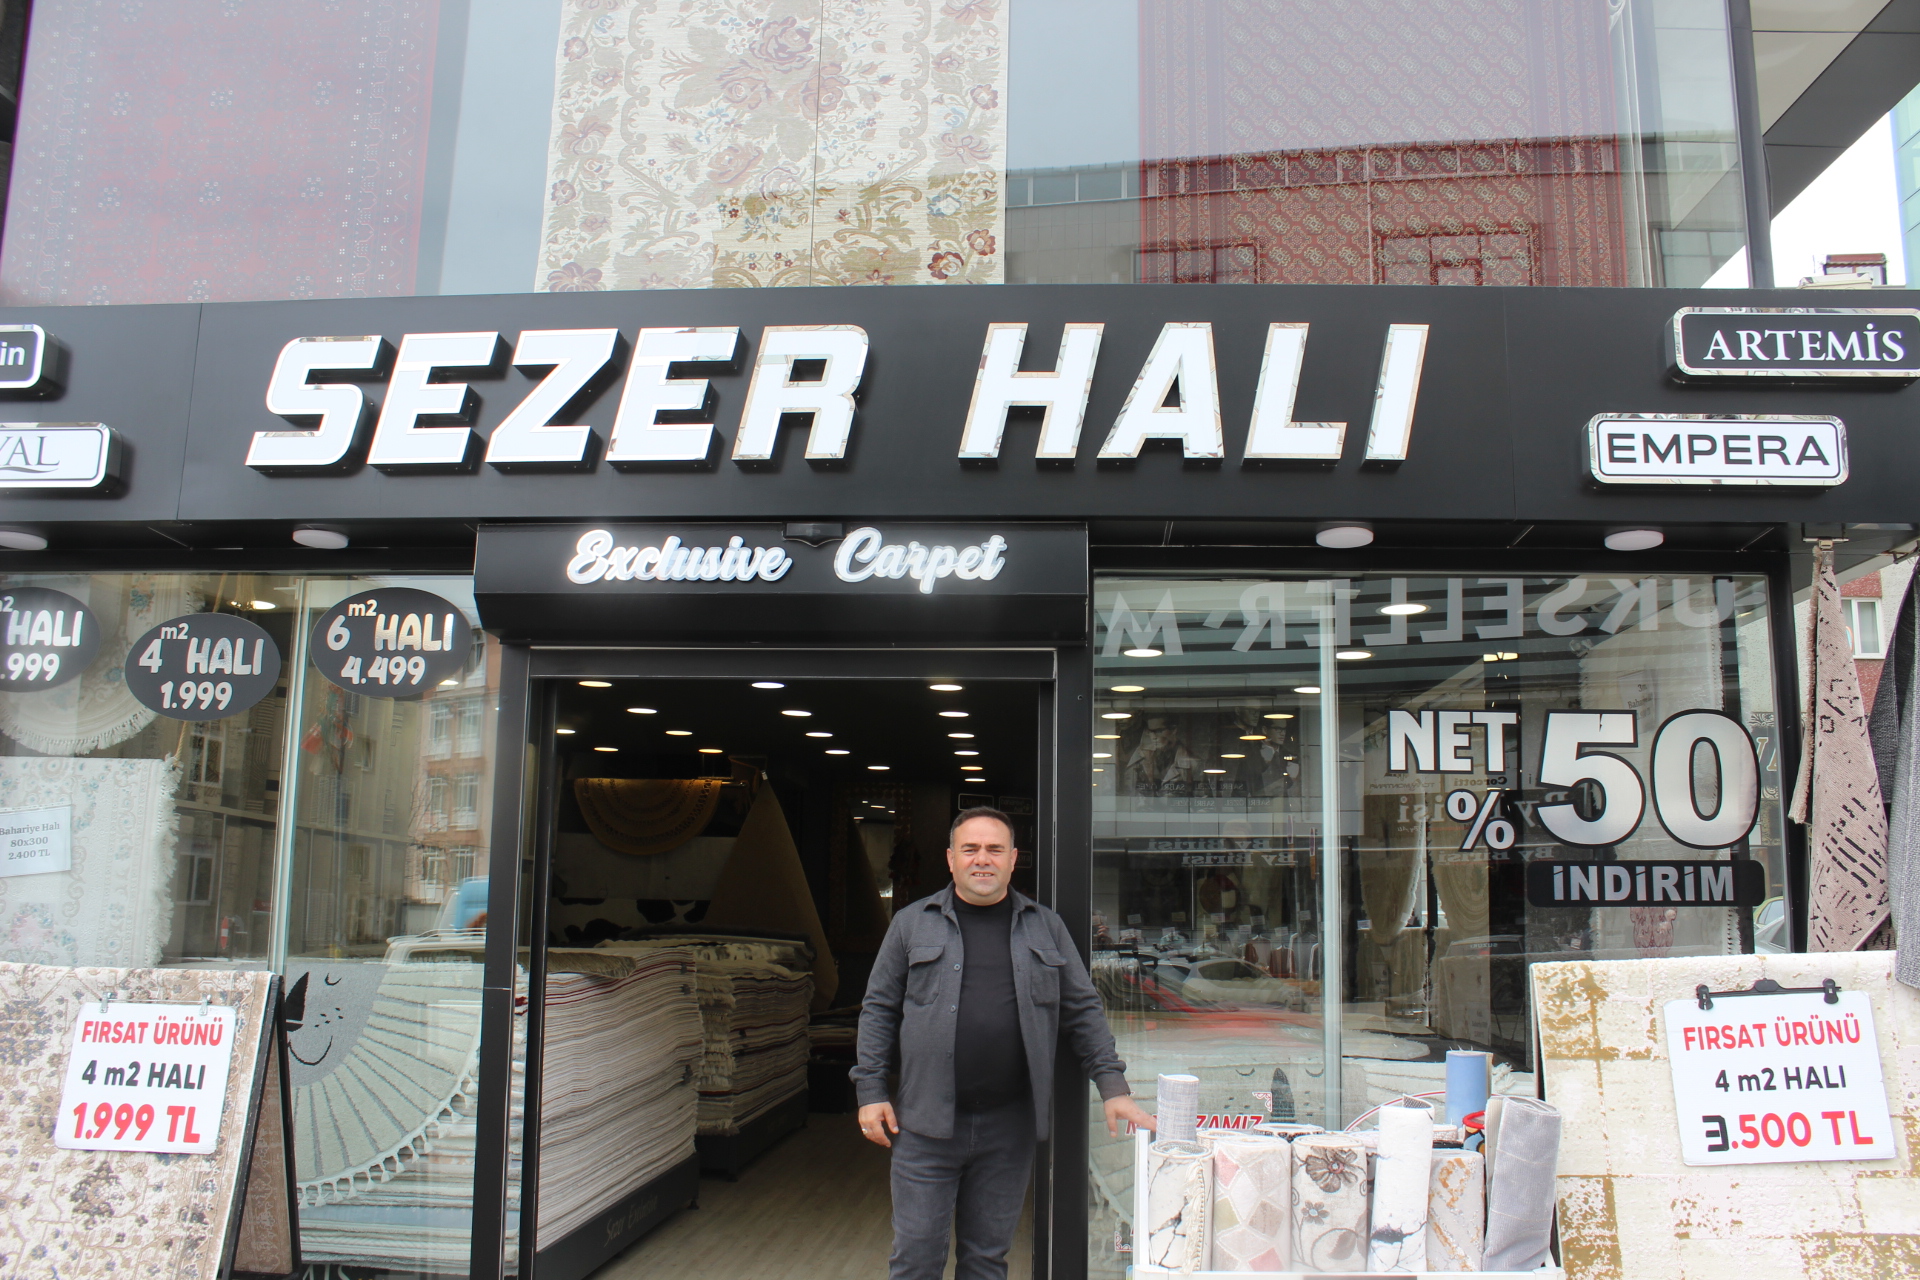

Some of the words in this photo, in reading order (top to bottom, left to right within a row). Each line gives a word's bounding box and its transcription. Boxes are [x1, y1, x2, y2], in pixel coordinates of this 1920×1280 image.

[245, 325, 870, 468] SEZER
[958, 321, 1431, 461] HALI
[1607, 433, 1830, 466] EMPERA
[564, 527, 793, 586] Exclusive
[833, 525, 1009, 595] Carpet
[6, 609, 84, 647] HALI
[326, 614, 351, 652] 6
[374, 613, 456, 652] HALI
[138, 638, 163, 674] 4
[186, 637, 265, 676] HALI
[340, 655, 427, 686] 4.499
[160, 681, 234, 711] 1.999
[1388, 709, 1519, 774] NET
[1446, 787, 1517, 853] %
[1537, 708, 1762, 849] 50
[0, 824, 41, 836] Bahariye
[10, 836, 49, 848] 80x300
[8, 849, 37, 861] 2.400
[38, 849, 51, 857] TL
[82, 1020, 149, 1045] FIRSAT
[153, 1015, 224, 1047] ÜRÜNÜ
[1683, 1023, 1767, 1051] FIRSAT
[1775, 1012, 1861, 1046] ÜRÜNÜ
[82, 1060, 97, 1086] 4
[104, 1061, 140, 1087] m2
[148, 1064, 206, 1090] HALI
[1715, 1069, 1730, 1093] 4
[1738, 1068, 1776, 1092] m2
[1784, 1065, 1847, 1091] HALI
[73, 1102, 155, 1141] 1.999
[166, 1106, 201, 1144] TL
[1820, 1110, 1874, 1147] TL
